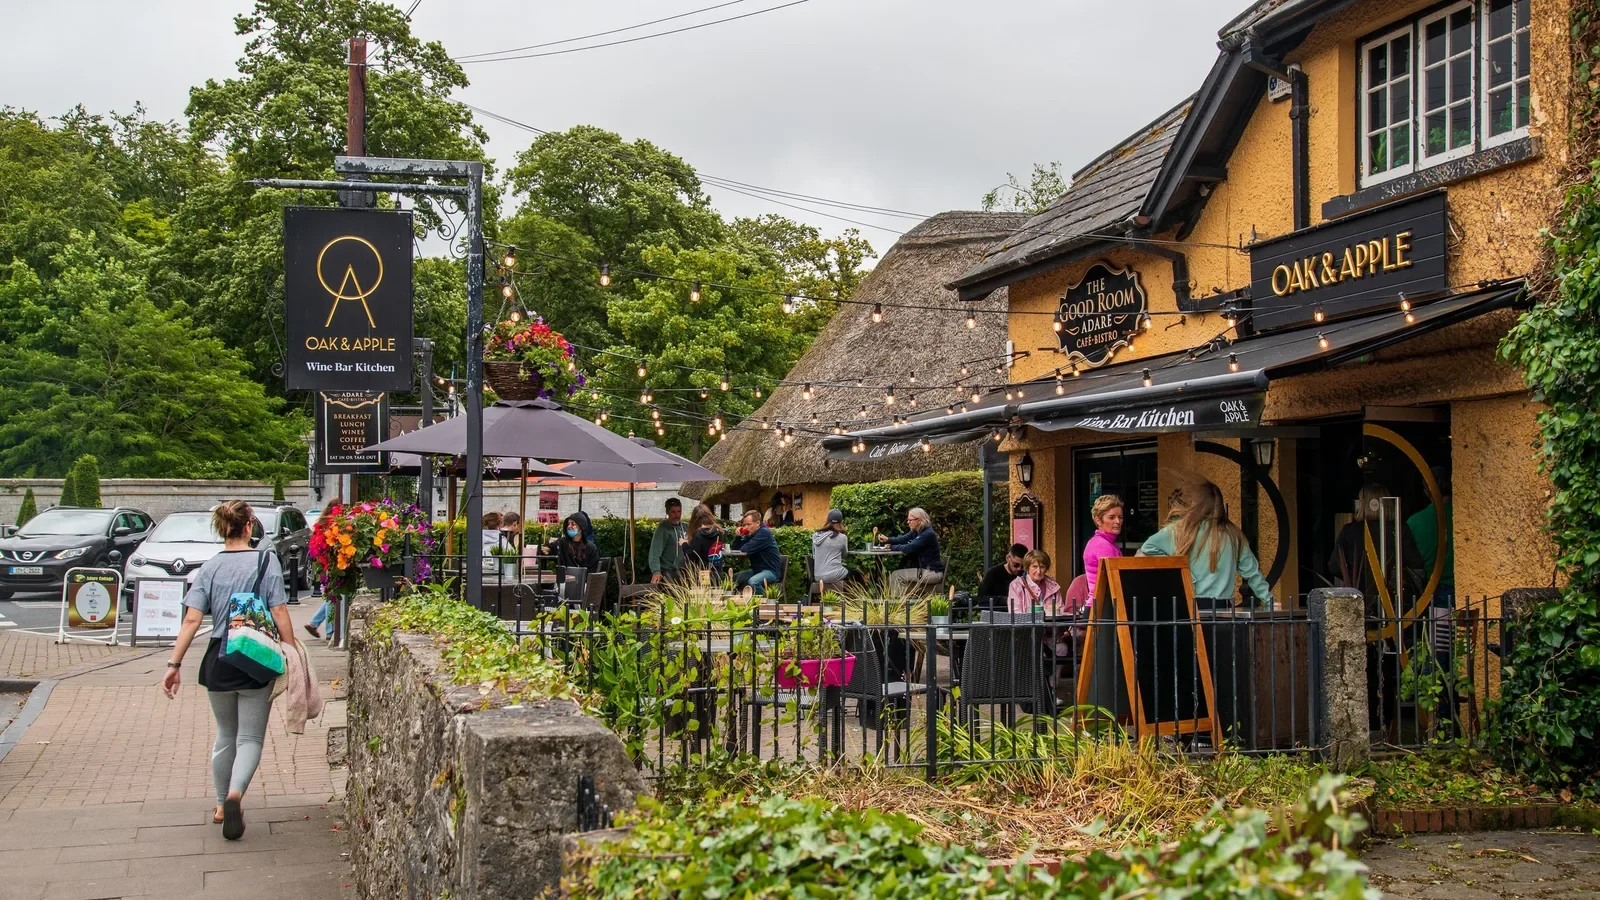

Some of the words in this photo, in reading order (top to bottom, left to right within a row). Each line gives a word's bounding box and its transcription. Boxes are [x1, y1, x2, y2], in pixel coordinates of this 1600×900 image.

[1271, 255, 1320, 297] OAK
[1320, 251, 1338, 286] &
[1339, 231, 1412, 281] APPLE
[1086, 277, 1105, 295] THE
[1060, 299, 1094, 322] GOOD
[1097, 287, 1135, 313] ROOM
[1081, 314, 1113, 334] ADARE
[305, 336, 339, 351] OAK
[340, 337, 350, 351] &
[352, 337, 396, 352] APPLE
[306, 361, 333, 372] Wine
[335, 362, 353, 372] Bar
[355, 362, 395, 373] Kitchen
[1220, 400, 1240, 413] OAK
[1238, 399, 1247, 411] &
[1108, 414, 1138, 429] Bar
[1135, 406, 1196, 428] Kitchen
[1225, 410, 1250, 424] APPLE
